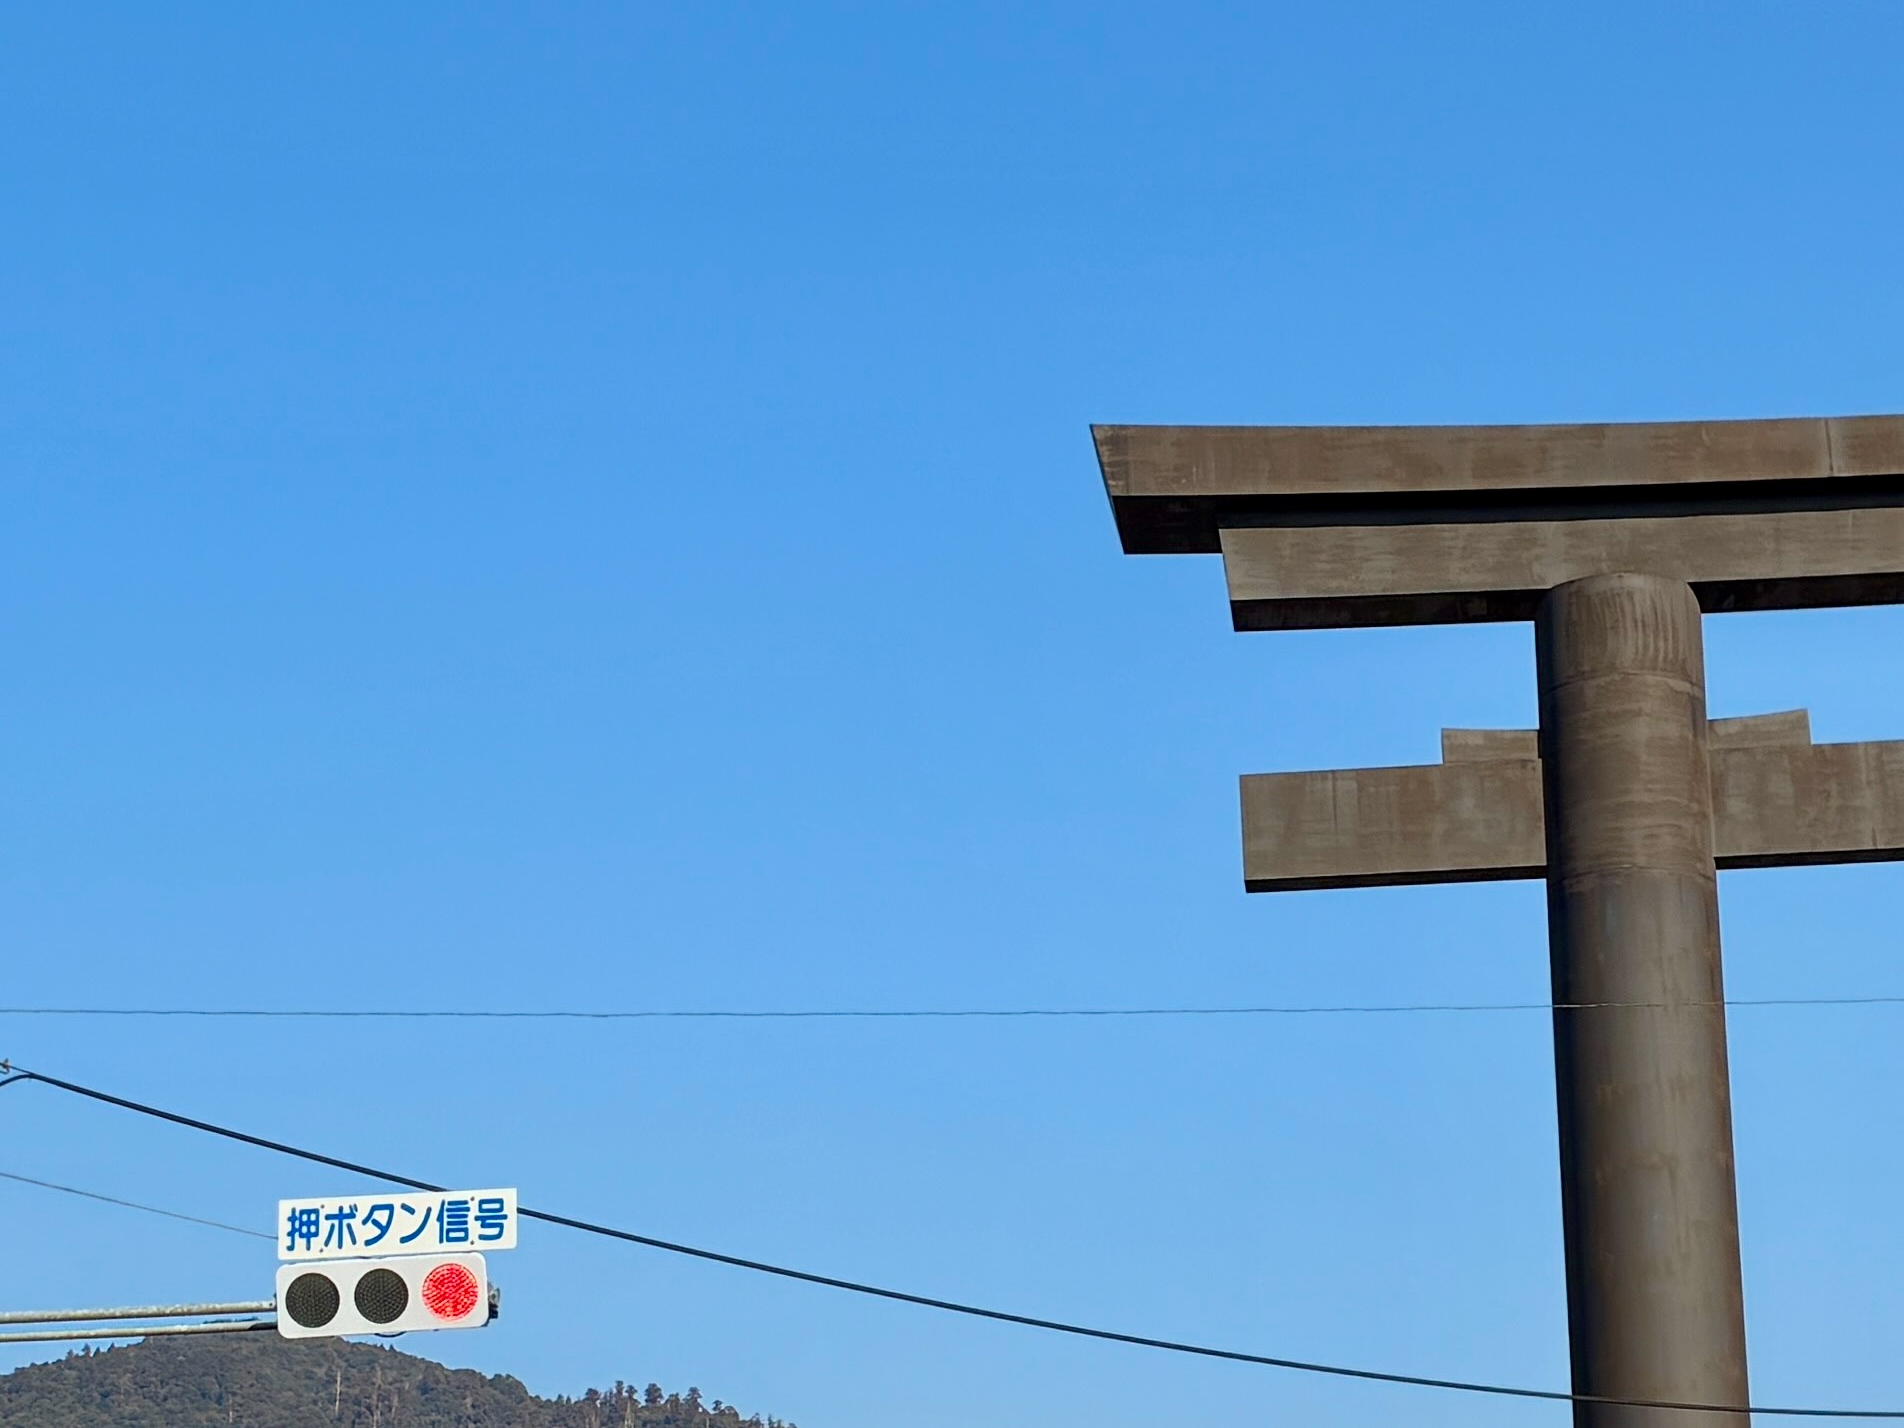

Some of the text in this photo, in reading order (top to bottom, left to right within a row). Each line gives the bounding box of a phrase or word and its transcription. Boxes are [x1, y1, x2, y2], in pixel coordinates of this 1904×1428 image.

[286, 1197, 508, 1252] 押ボタン信号
